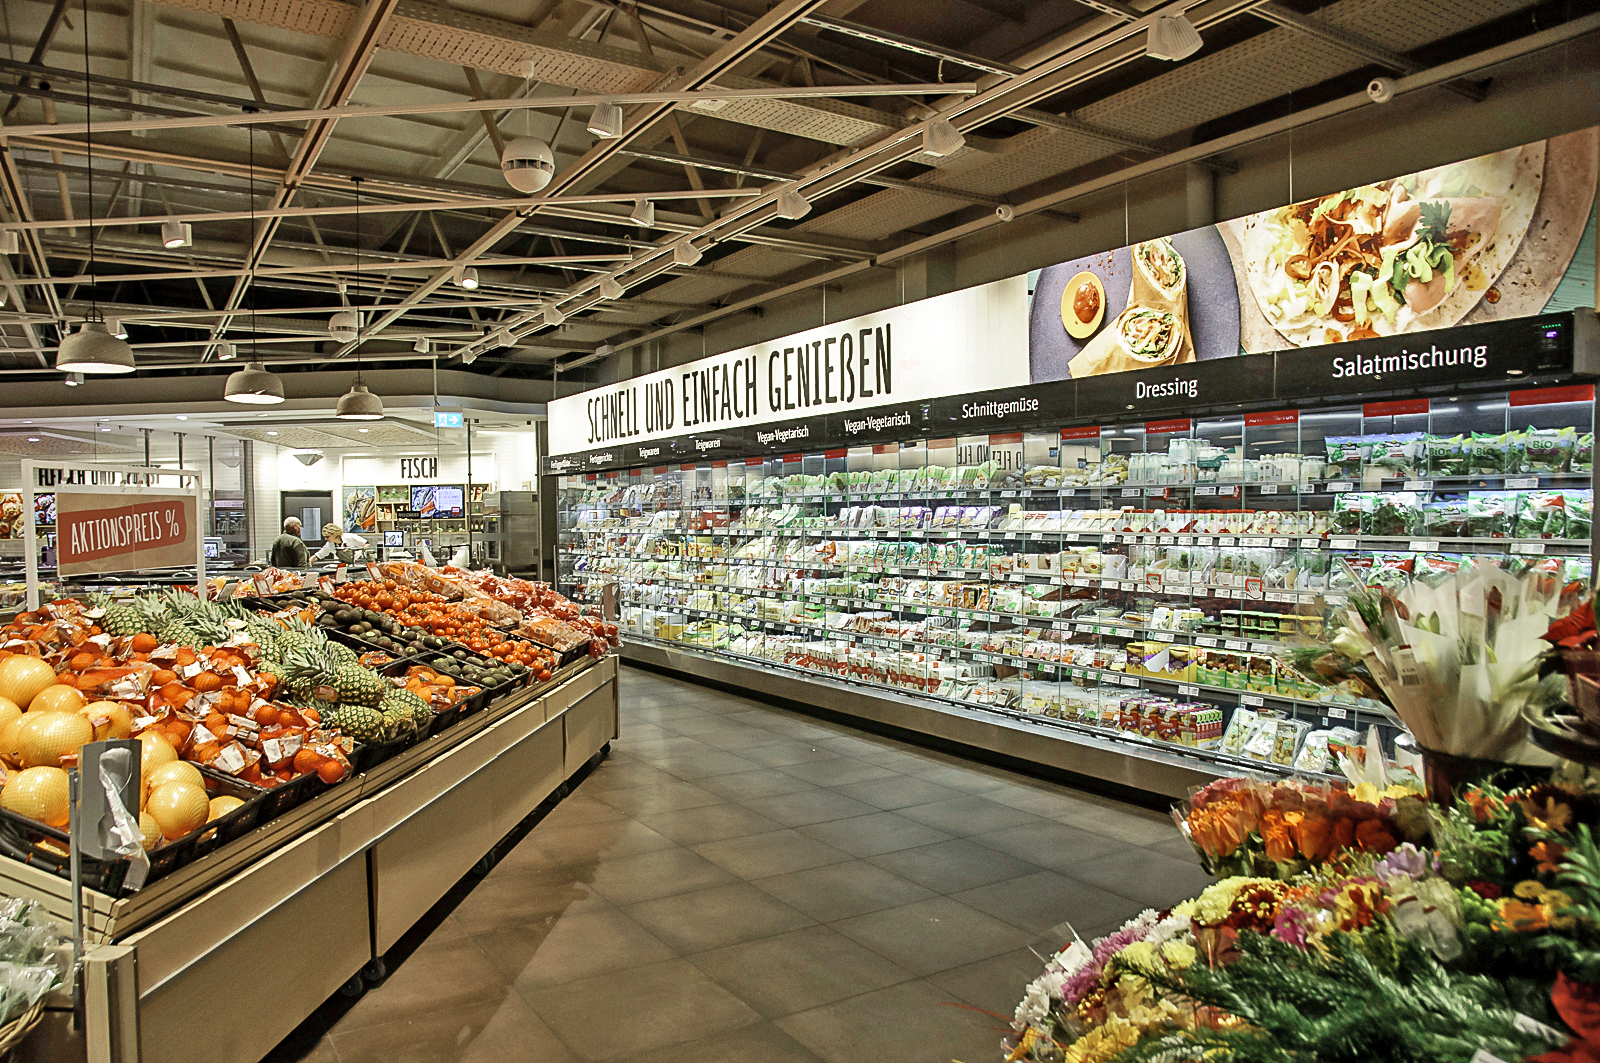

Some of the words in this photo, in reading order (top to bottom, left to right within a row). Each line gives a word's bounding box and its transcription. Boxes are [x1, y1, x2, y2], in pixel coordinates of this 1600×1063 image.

[1332, 345, 1488, 378] Salatmischung
[587, 386, 640, 444] SCHNELL
[645, 378, 675, 433] UND
[683, 355, 758, 427] EINFACH
[769, 323, 892, 413] GENIEßEN
[1136, 378, 1198, 399] Dressing
[962, 397, 1039, 419] Schnittgemüse
[844, 411, 911, 434] Vegan-Vegetarisch
[695, 439, 721, 451] Teigwaren
[756, 425, 809, 445] Vegan-Vegetarisch
[639, 447, 660, 459] Teigwaren
[400, 457, 438, 479] FISCH
[71, 511, 162, 555] AKTIONSPREIS
[165, 509, 180, 538] %
